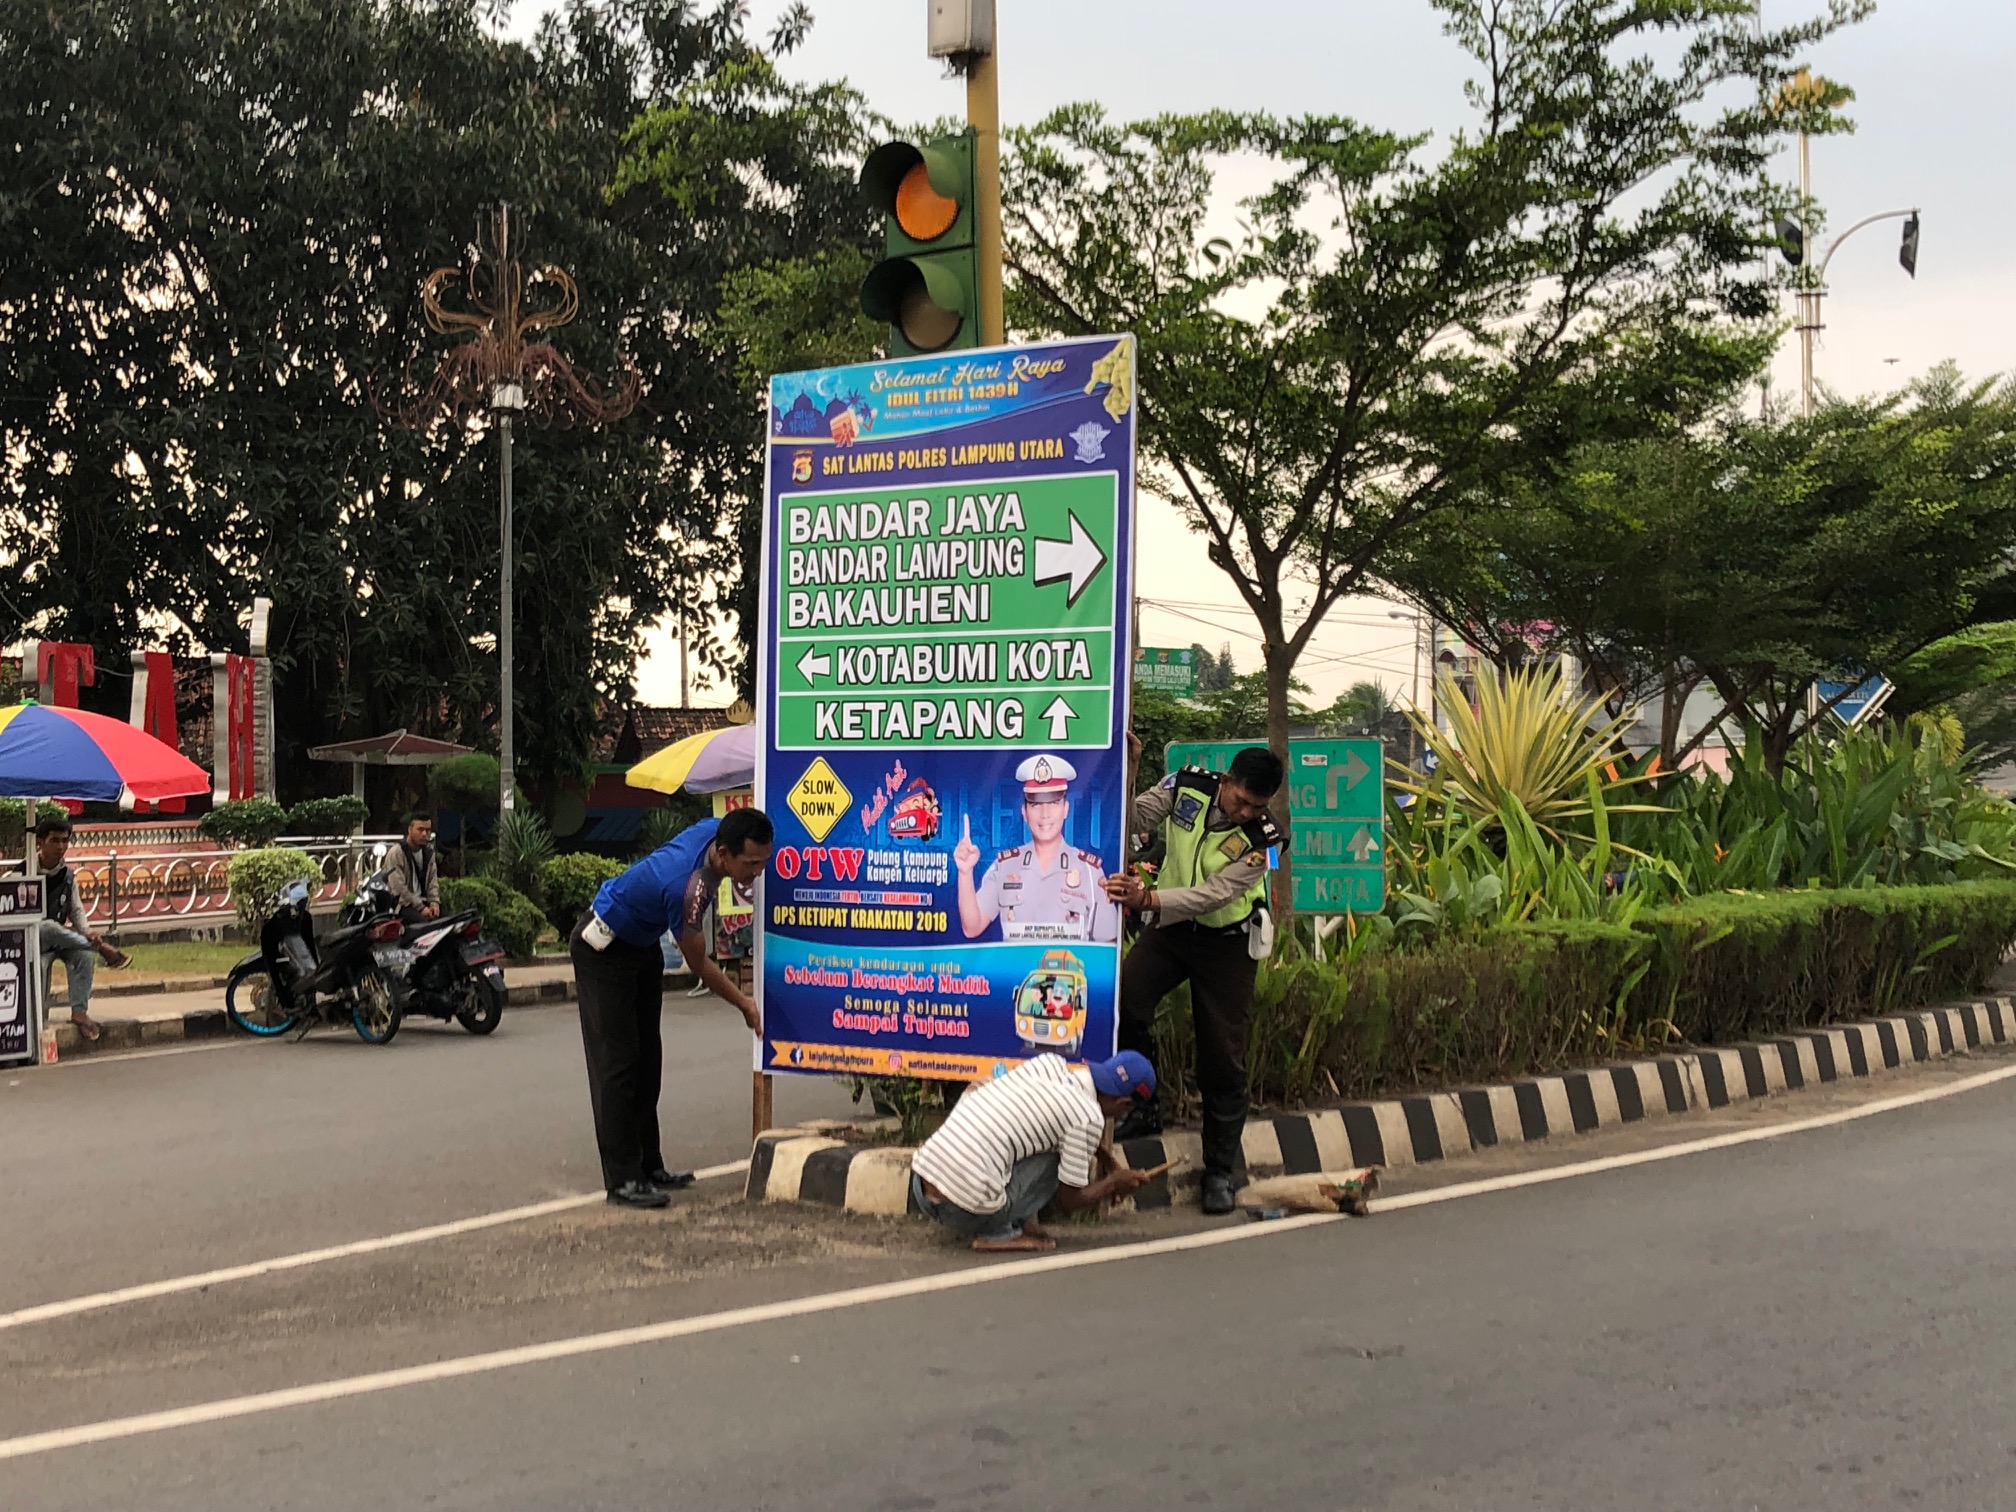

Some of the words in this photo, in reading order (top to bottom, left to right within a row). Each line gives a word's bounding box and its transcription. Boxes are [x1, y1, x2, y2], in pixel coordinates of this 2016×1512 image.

[869, 365, 950, 393] Selamat
[952, 361, 1001, 386] Hari
[1007, 354, 1066, 382] Raya
[887, 391, 920, 408] IDUL
[925, 387, 963, 404] FITRI
[822, 455, 845, 475] SAT
[848, 451, 894, 473] LANTAS
[899, 447, 947, 470] POLRES
[951, 442, 1015, 466] LAMPUNG
[1019, 438, 1064, 460] UTARA
[789, 499, 930, 544] BANDAR
[939, 492, 1026, 536] JAYA
[788, 542, 889, 586] BANDAR
[895, 537, 1024, 582] LAMPUNG
[787, 583, 991, 628] BAKAUHENI
[837, 642, 997, 685] KOTABUMI
[1008, 639, 1092, 682] KOTA
[815, 698, 1024, 741] KETAPANG
[803, 780, 837, 795] SLOW.
[801, 802, 838, 816] DOWN.
[775, 846, 865, 881] OTW
[868, 849, 900, 868] Pulang
[903, 850, 948, 871] Kampung
[867, 867, 902, 885] Kangen
[905, 868, 948, 886] Keluarga
[1315, 877, 1370, 902] KOTA
[773, 906, 796, 926] OPS
[798, 907, 848, 928] KETUPAT
[851, 909, 913, 931] KRAKATAU
[916, 911, 948, 932] 2018
[808, 954, 853, 968] Periksa
[859, 956, 925, 973] kendaraan
[931, 961, 961, 974] anda
[784, 965, 848, 987] Sebelum
[852, 970, 934, 995] Berangkat
[938, 974, 990, 995] Mudik
[845, 995, 900, 1015] Semoga
[907, 998, 969, 1017] Selamat
[833, 1008, 898, 1035] Sampai
[903, 1012, 970, 1039] Tujuan
